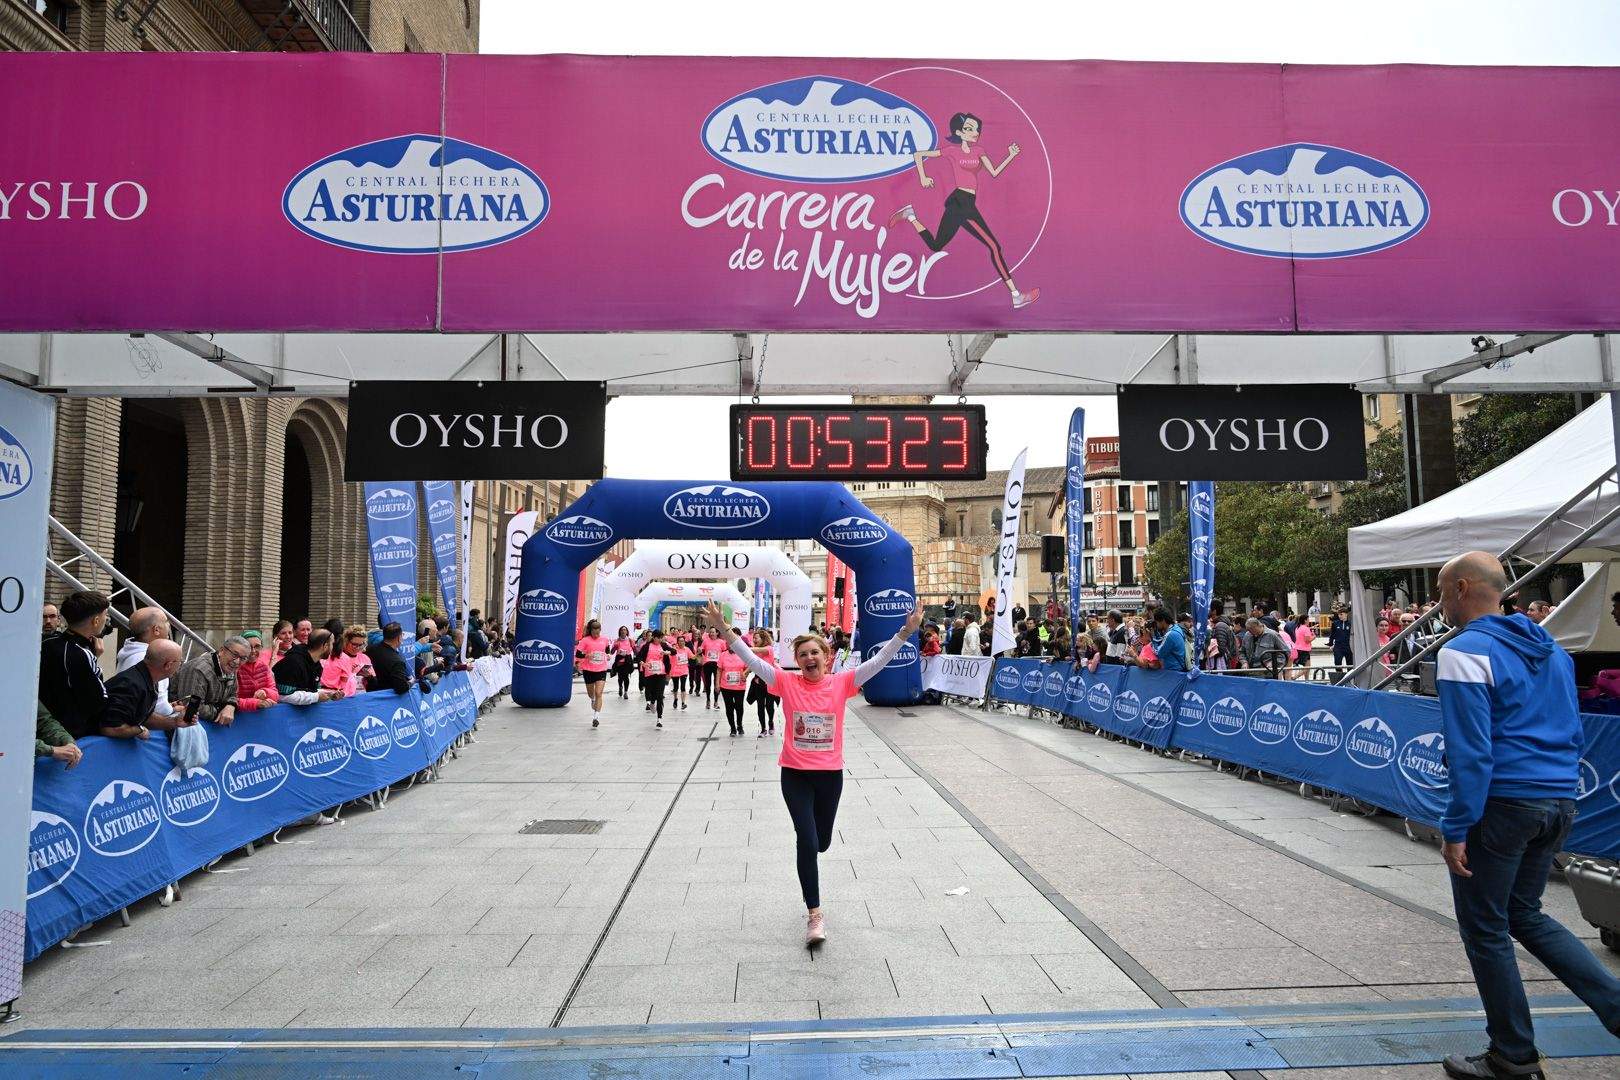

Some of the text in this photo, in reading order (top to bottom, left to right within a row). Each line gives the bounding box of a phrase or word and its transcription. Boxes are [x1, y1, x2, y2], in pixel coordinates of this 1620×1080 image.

[757, 112, 912, 125] CENTRAL LECHERA
[720, 114, 917, 155] ASTURIANA
[346, 175, 521, 188] CENTRAL LECHERA
[1237, 183, 1402, 195] CENTRAL LECHERA
[303, 178, 529, 222] ASTURIANA
[681, 173, 875, 231] Carrera
[1200, 186, 1412, 227] ASTURIANA
[728, 226, 949, 319] de la Mujer
[390, 413, 568, 449] OYSHO
[1158, 417, 1330, 453] OYSHO
[1089, 442, 1120, 454] TIBUR
[672, 498, 763, 518] ASTURIANA
[550, 526, 608, 540] ASTURIANA
[827, 528, 884, 540] ASTURIANA
[667, 553, 750, 569] OYSHO
[520, 598, 565, 612] ASTURIANA
[868, 600, 913, 611] ASTURIANA
[515, 647, 560, 662] ASTURIANA
[941, 658, 980, 679] OYSHO
[1210, 708, 1243, 728] ASTURIANA
[1250, 715, 1287, 737] ASTURIANA
[359, 733, 390, 752] ASTURIANA
[1295, 722, 1338, 747] ASTURIANA
[298, 744, 349, 770] ASTURIANA
[1348, 732, 1392, 761] ASTURIANA
[228, 762, 286, 794] ASTURIANA
[165, 785, 218, 816] ASTURIANA
[34, 827, 67, 844] LECHERA
[92, 804, 160, 847] ASTURIANA
